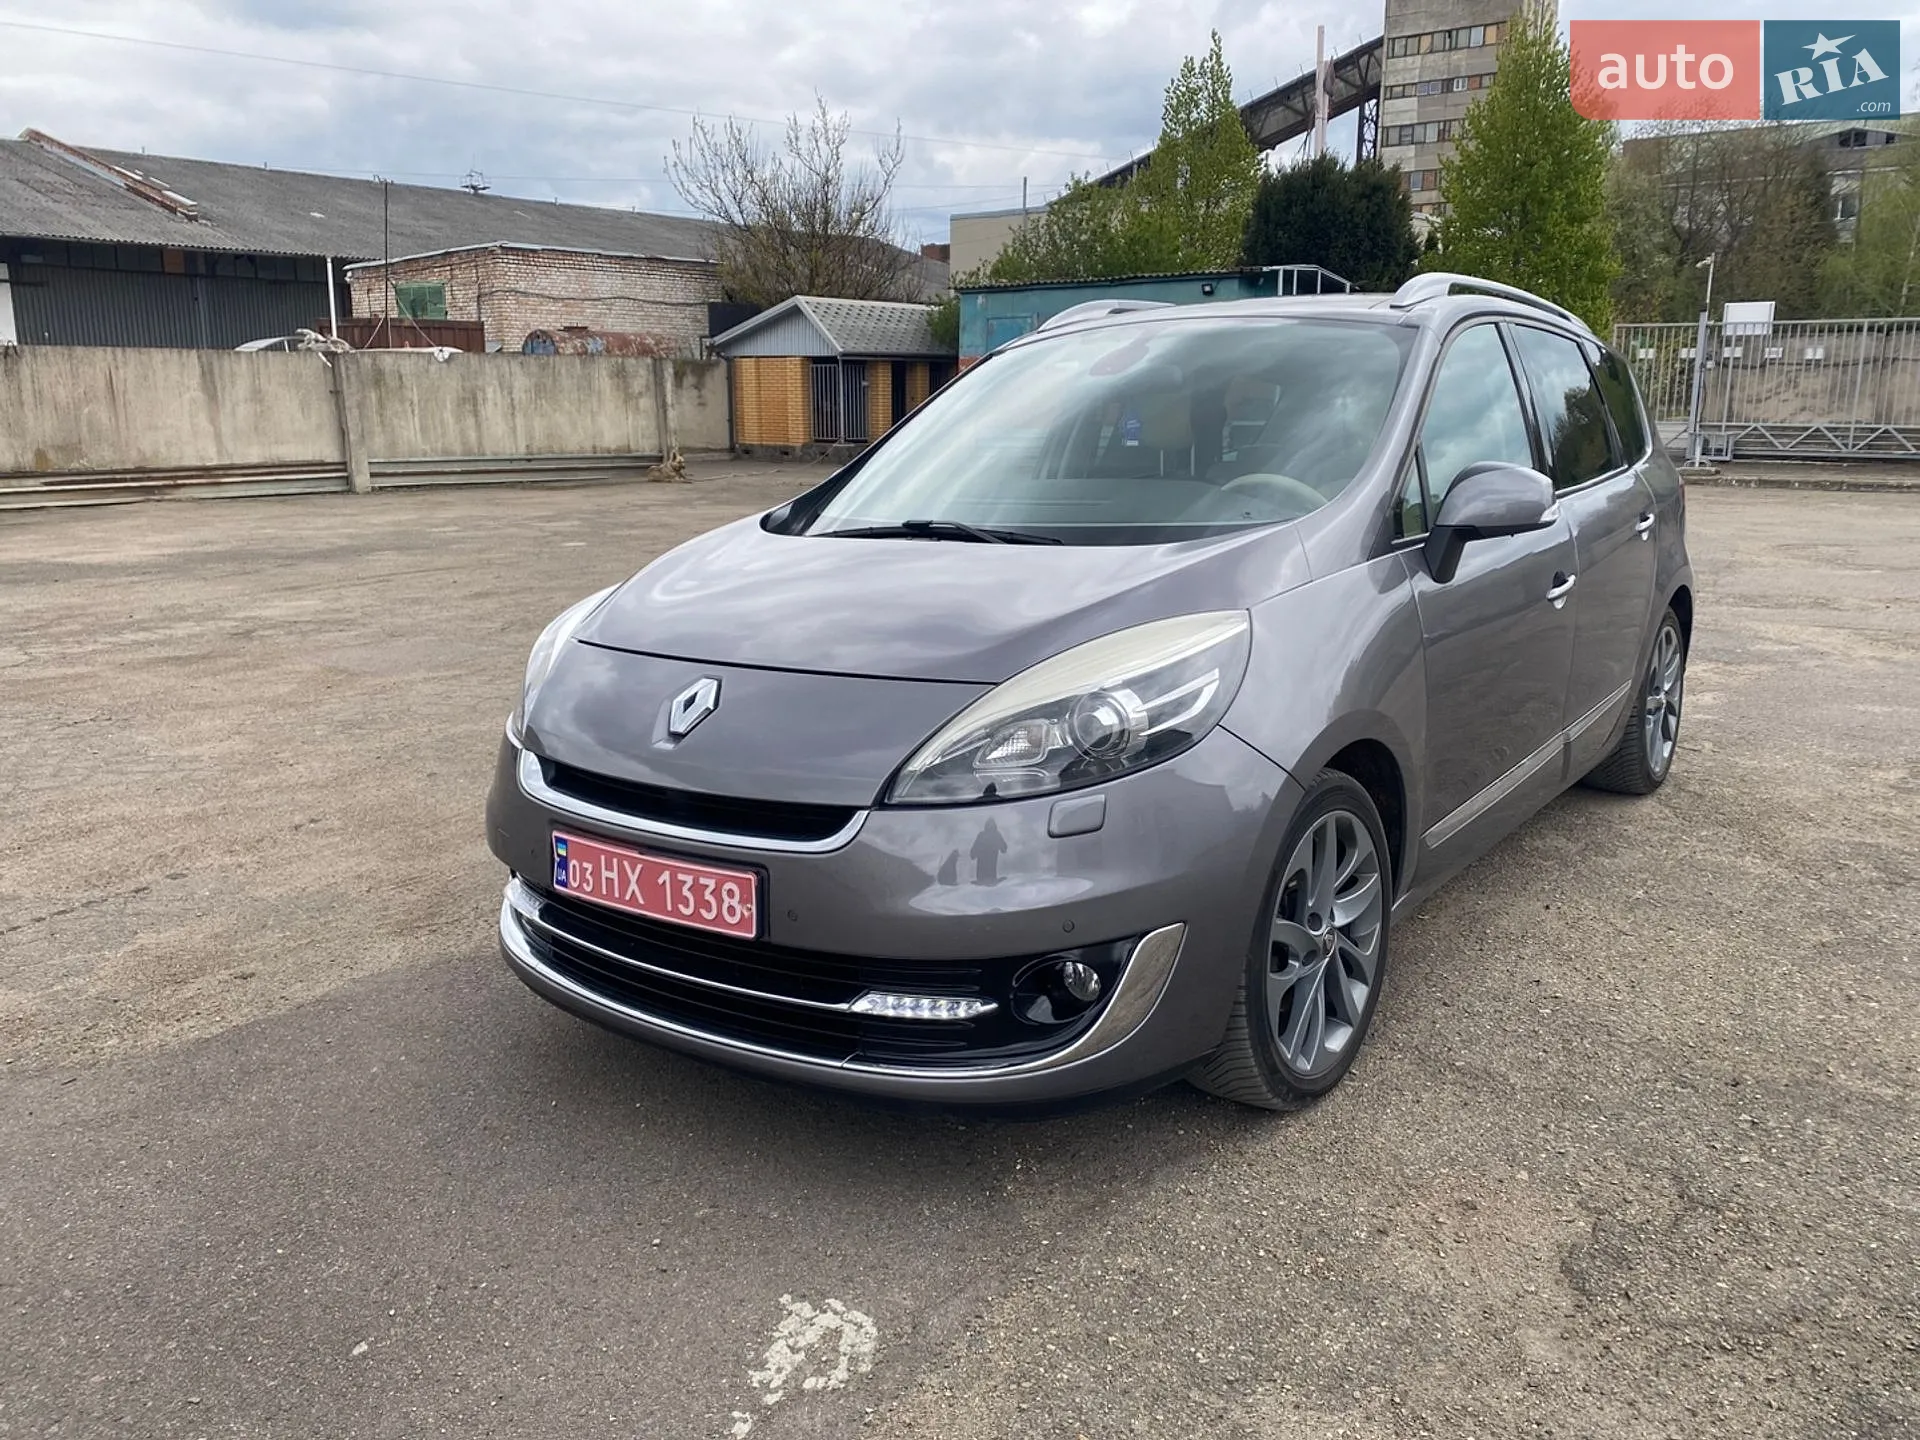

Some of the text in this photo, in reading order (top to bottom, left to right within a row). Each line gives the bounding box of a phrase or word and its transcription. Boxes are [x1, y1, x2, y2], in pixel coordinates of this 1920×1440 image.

[557, 867, 567, 882] UA
[569, 855, 741, 924] 03 HX 1338
